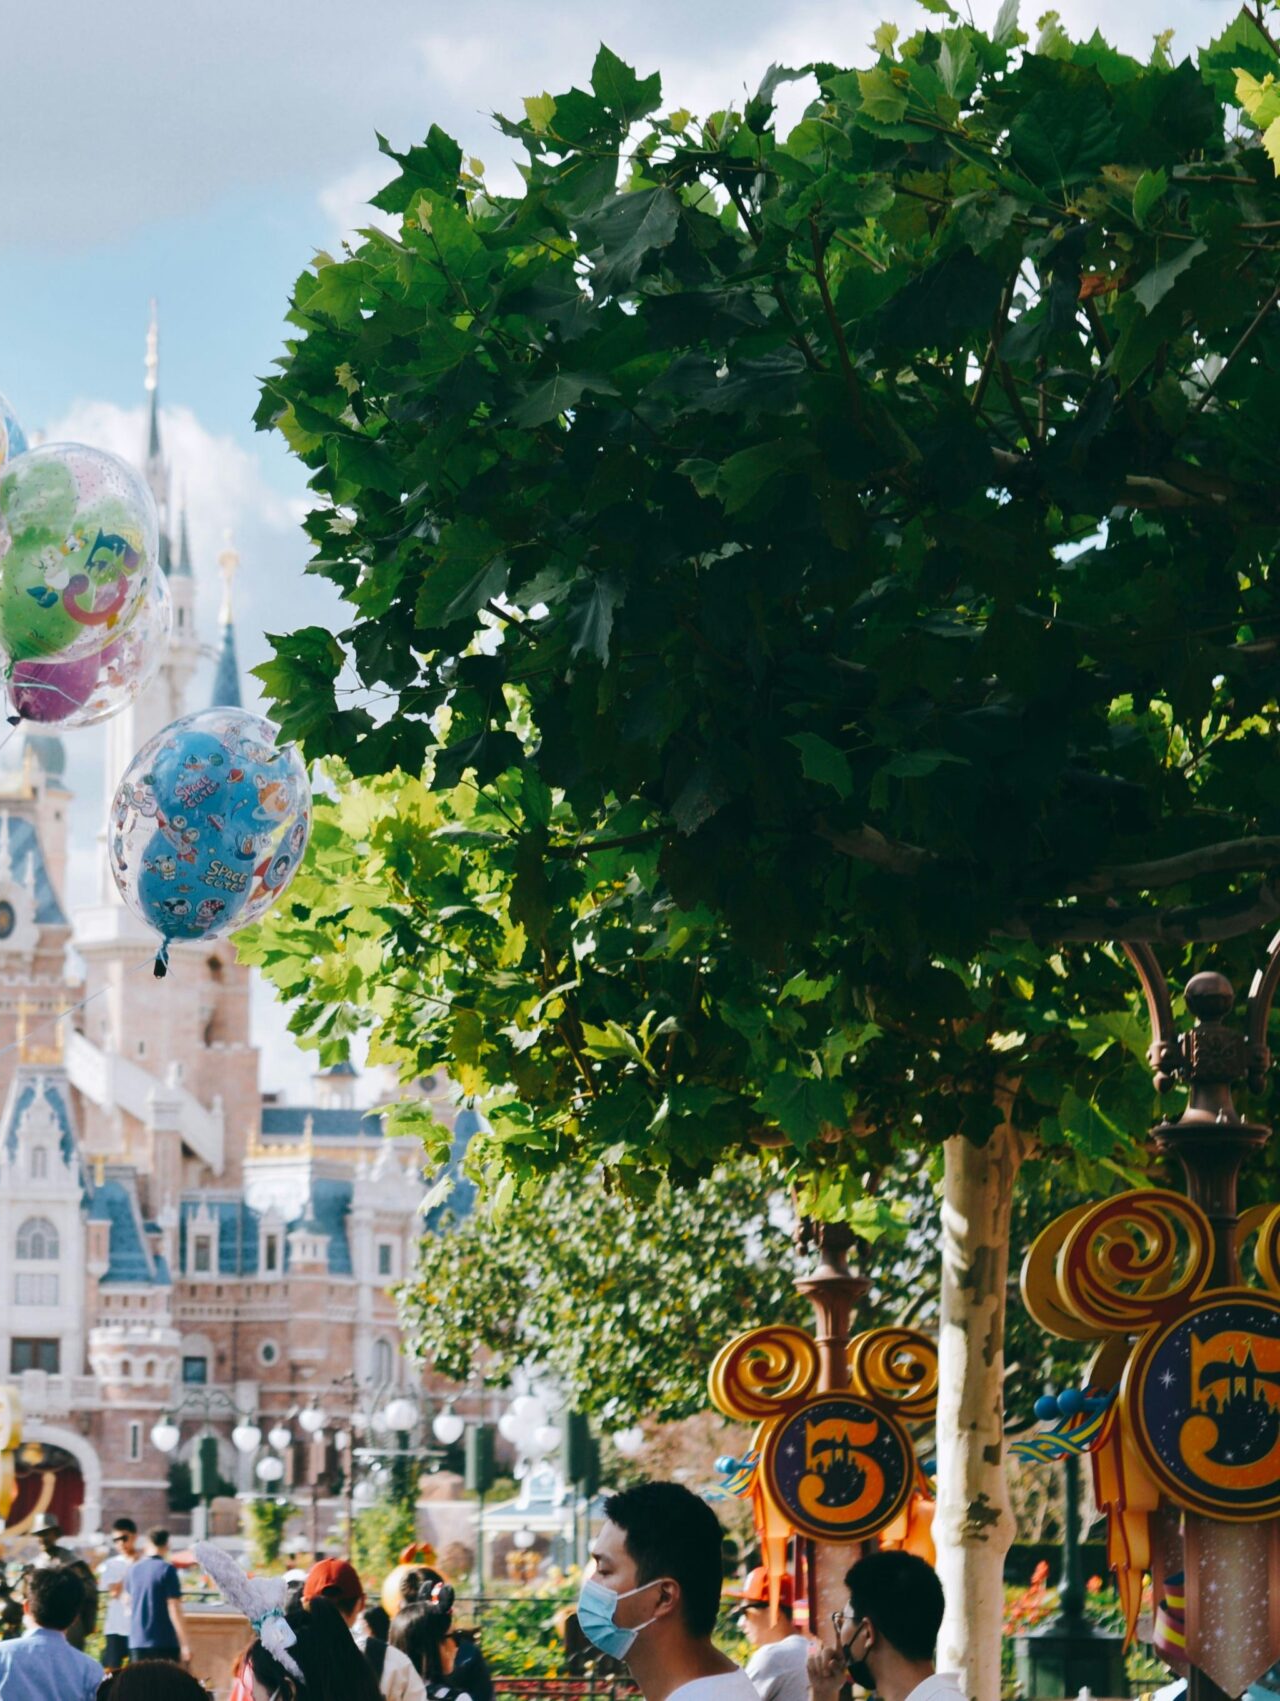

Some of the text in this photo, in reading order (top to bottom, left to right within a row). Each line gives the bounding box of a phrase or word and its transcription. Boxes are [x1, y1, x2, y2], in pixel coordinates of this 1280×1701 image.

[63, 527, 140, 625] 5
[175, 775, 210, 801] SPACE
[206, 860, 248, 884] SPACE
[1177, 1328, 1280, 1491] 5
[797, 1416, 886, 1524] 5
